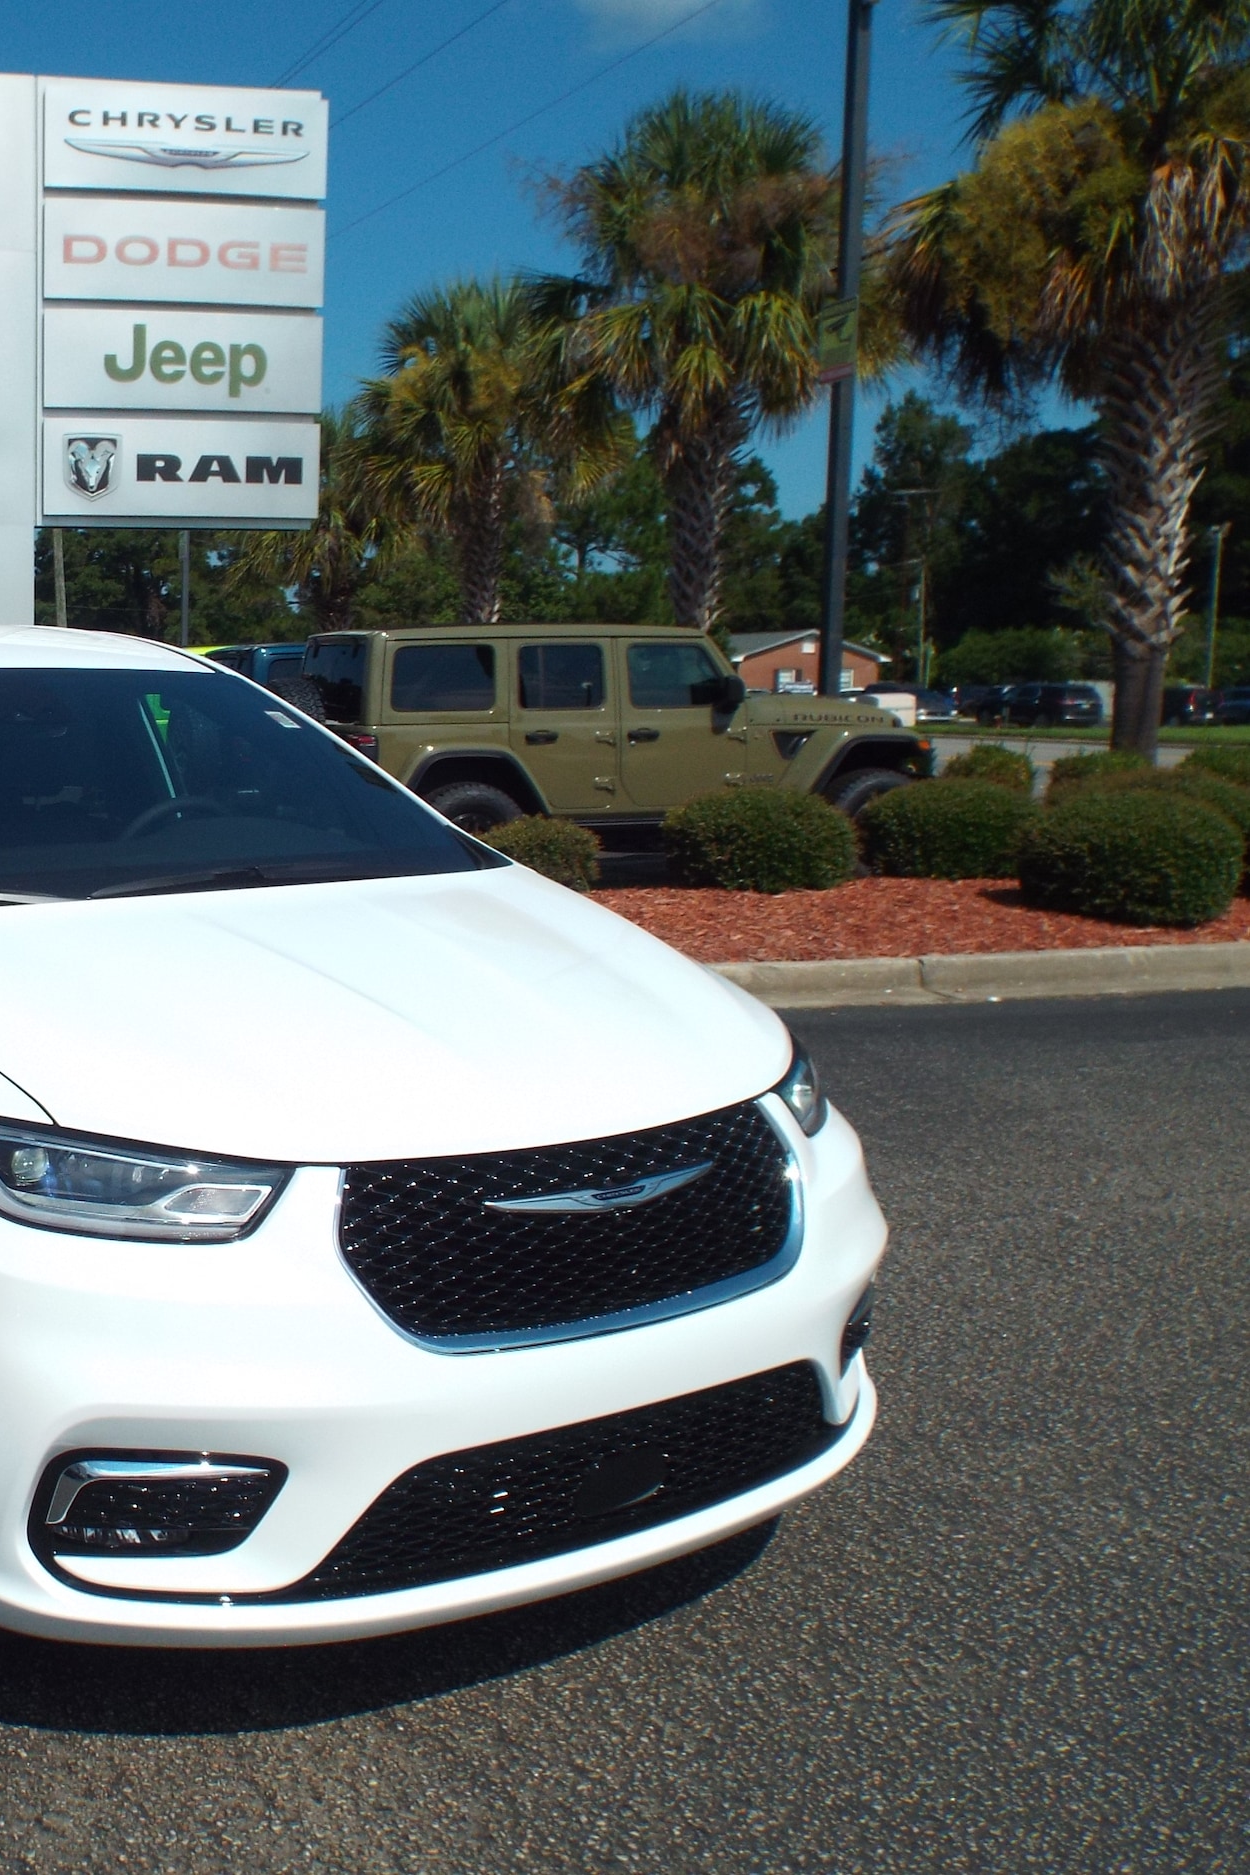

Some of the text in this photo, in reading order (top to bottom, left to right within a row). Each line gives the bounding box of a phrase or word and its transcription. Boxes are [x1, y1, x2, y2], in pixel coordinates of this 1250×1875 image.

[67, 109, 305, 138] CHRYSLER
[62, 234, 308, 274] DODGE
[104, 323, 267, 398] Jeep
[136, 453, 303, 485] RAM
[792, 713, 885, 724] RUBICON
